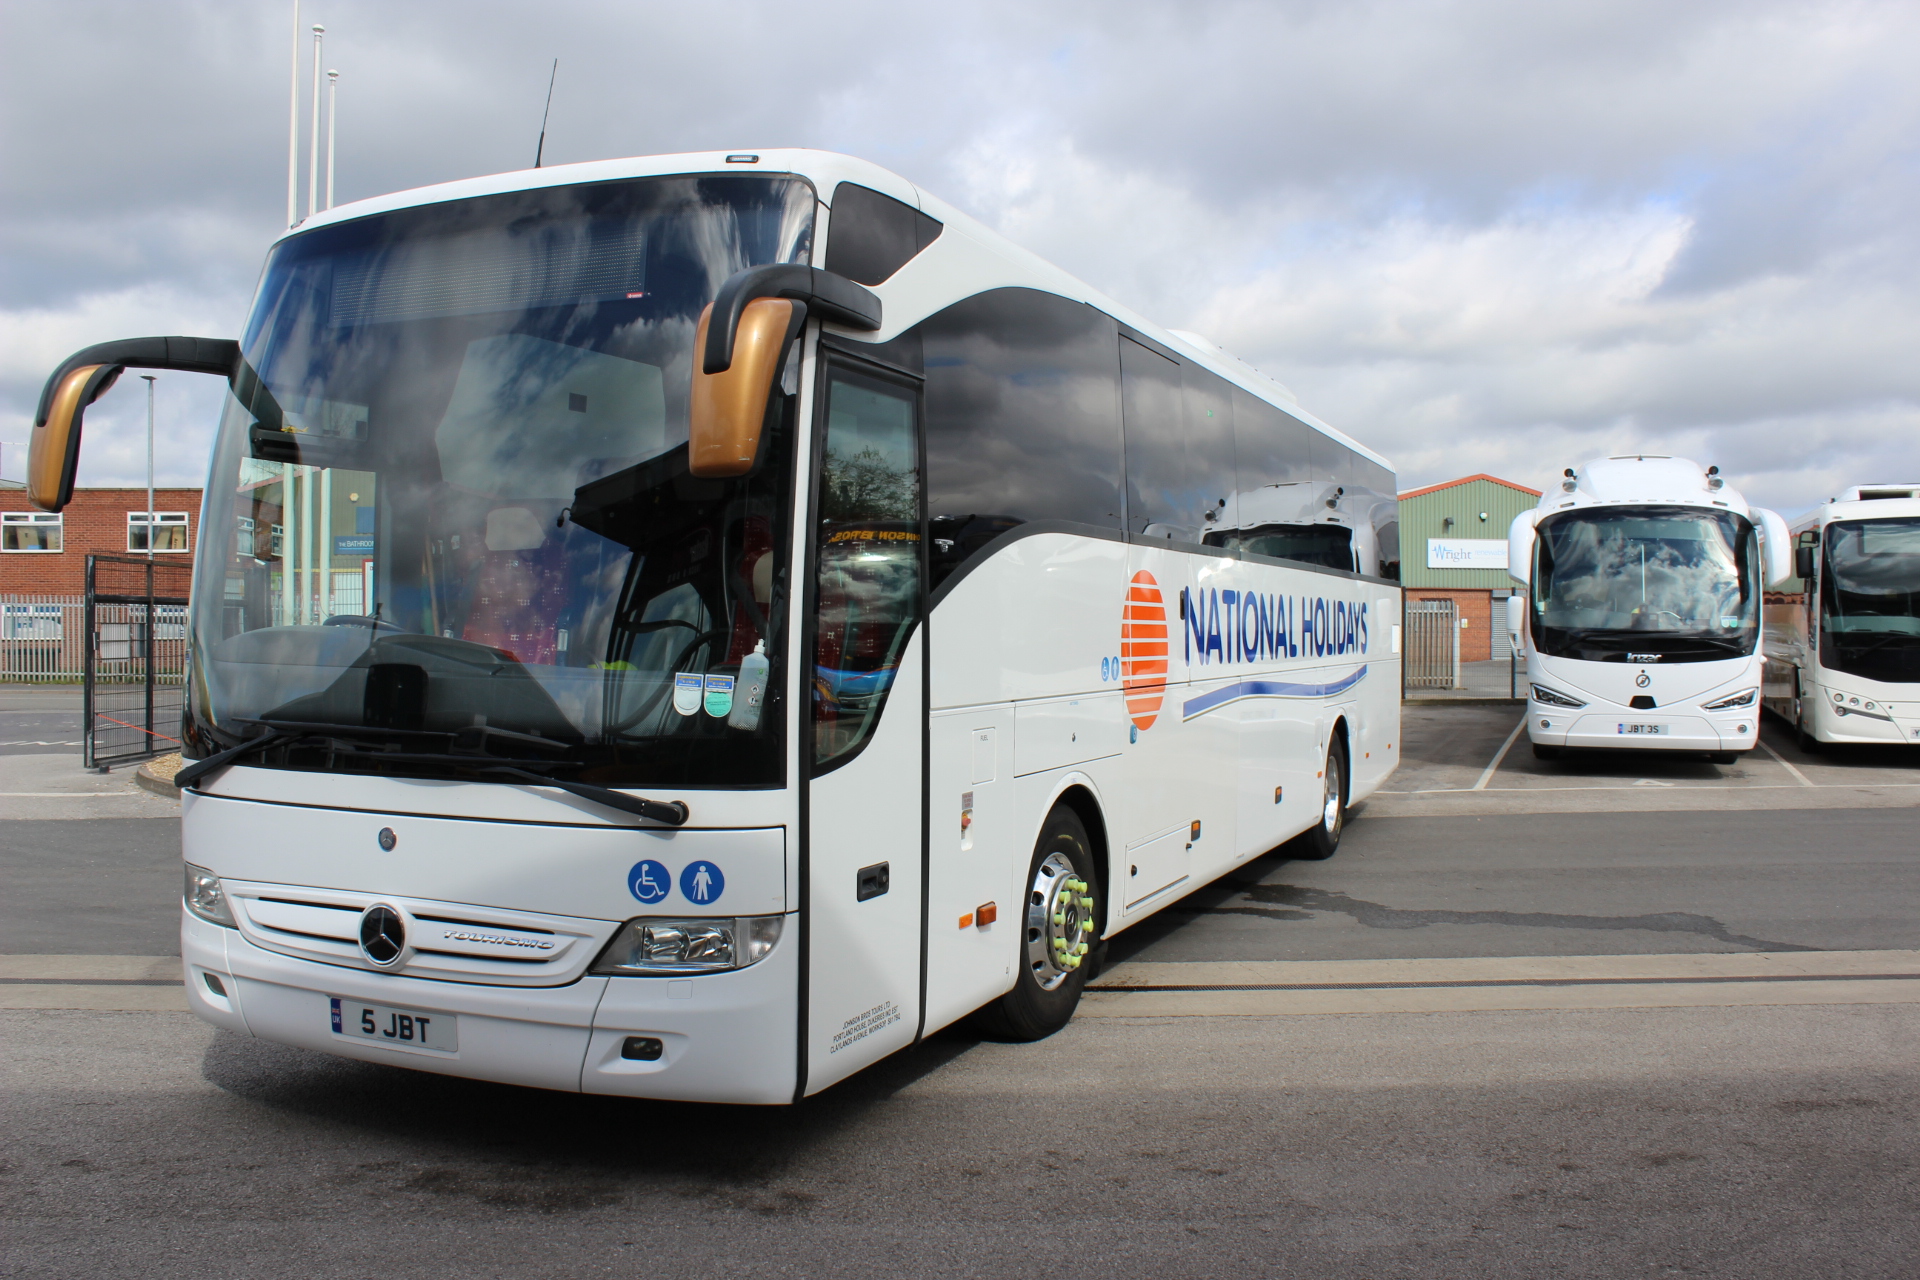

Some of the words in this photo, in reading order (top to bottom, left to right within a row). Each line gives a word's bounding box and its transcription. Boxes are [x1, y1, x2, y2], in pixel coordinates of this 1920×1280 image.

[1432, 544, 1472, 562] Wright
[1184, 585, 1298, 667] NATIONAL
[1302, 596, 1368, 658] HOLIDAYS
[1626, 653, 1662, 663] Irizar
[1628, 725, 1645, 733] JBT
[1647, 725, 1659, 733] 3S
[443, 930, 555, 949] TOURISMO
[332, 1014, 341, 1023] UK
[361, 1008, 376, 1034] 5
[383, 1013, 430, 1043] JBT
[843, 1015, 860, 1030] JOHNSON
[861, 1010, 871, 1021] BROS
[871, 1004, 883, 1015] TOURS
[854, 1021, 867, 1032] HOUSE
